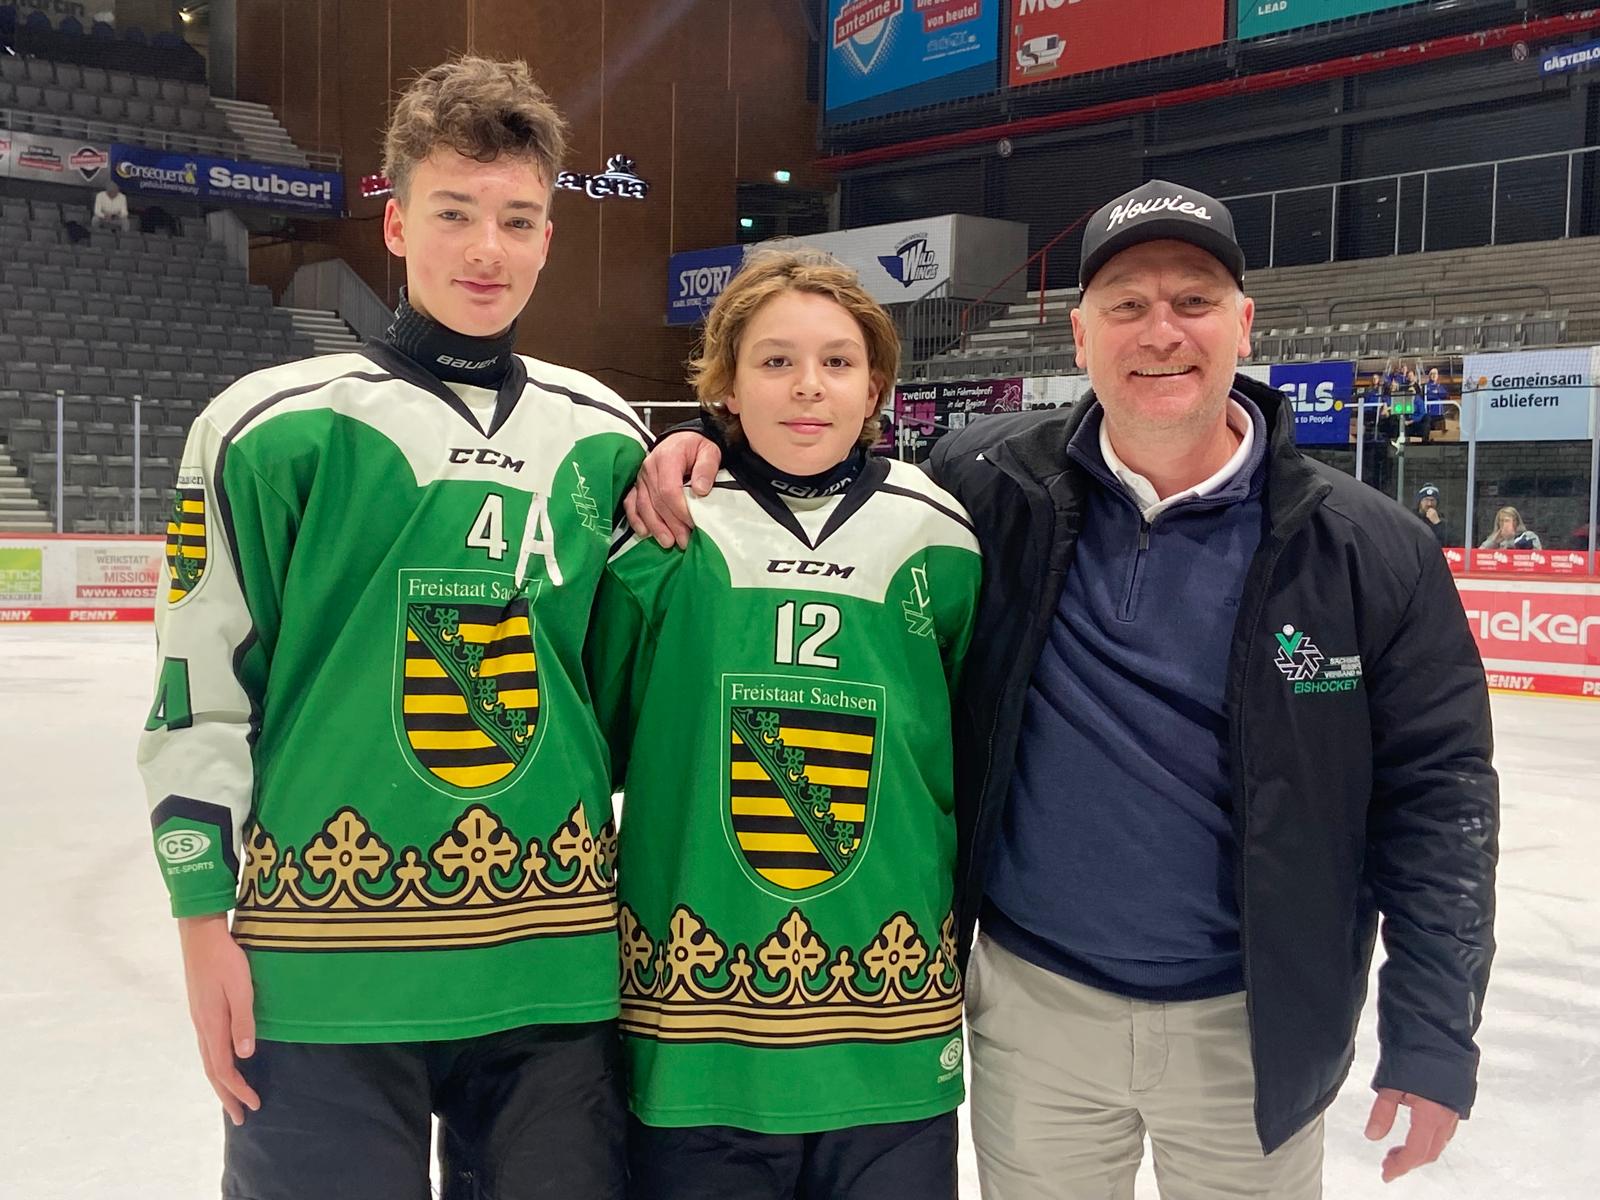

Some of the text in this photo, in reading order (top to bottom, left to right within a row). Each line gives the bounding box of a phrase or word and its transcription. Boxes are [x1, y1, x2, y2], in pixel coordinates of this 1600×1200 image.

[927, 2, 978, 28] von heute!
[1257, 1, 1288, 16] LEAD
[838, 0, 891, 39] antenne
[209, 166, 332, 200] Sauber!
[1105, 194, 1212, 232] Howies
[1491, 373, 1582, 388] Gemeinsam
[902, 387, 937, 401] zweirad
[1490, 393, 1559, 408] abliefern
[1309, 415, 1333, 425] People
[449, 448, 525, 473] CCM
[466, 492, 508, 561] 4
[514, 492, 564, 588] A
[97, 555, 149, 565] WERKSTATT
[766, 559, 856, 579] CCM
[407, 577, 486, 598] Freistaat
[774, 600, 841, 669] 12
[731, 683, 877, 712] Freistaat Sachsen
[1294, 680, 1358, 694] EISHOCKEY
[166, 838, 194, 854] CS
